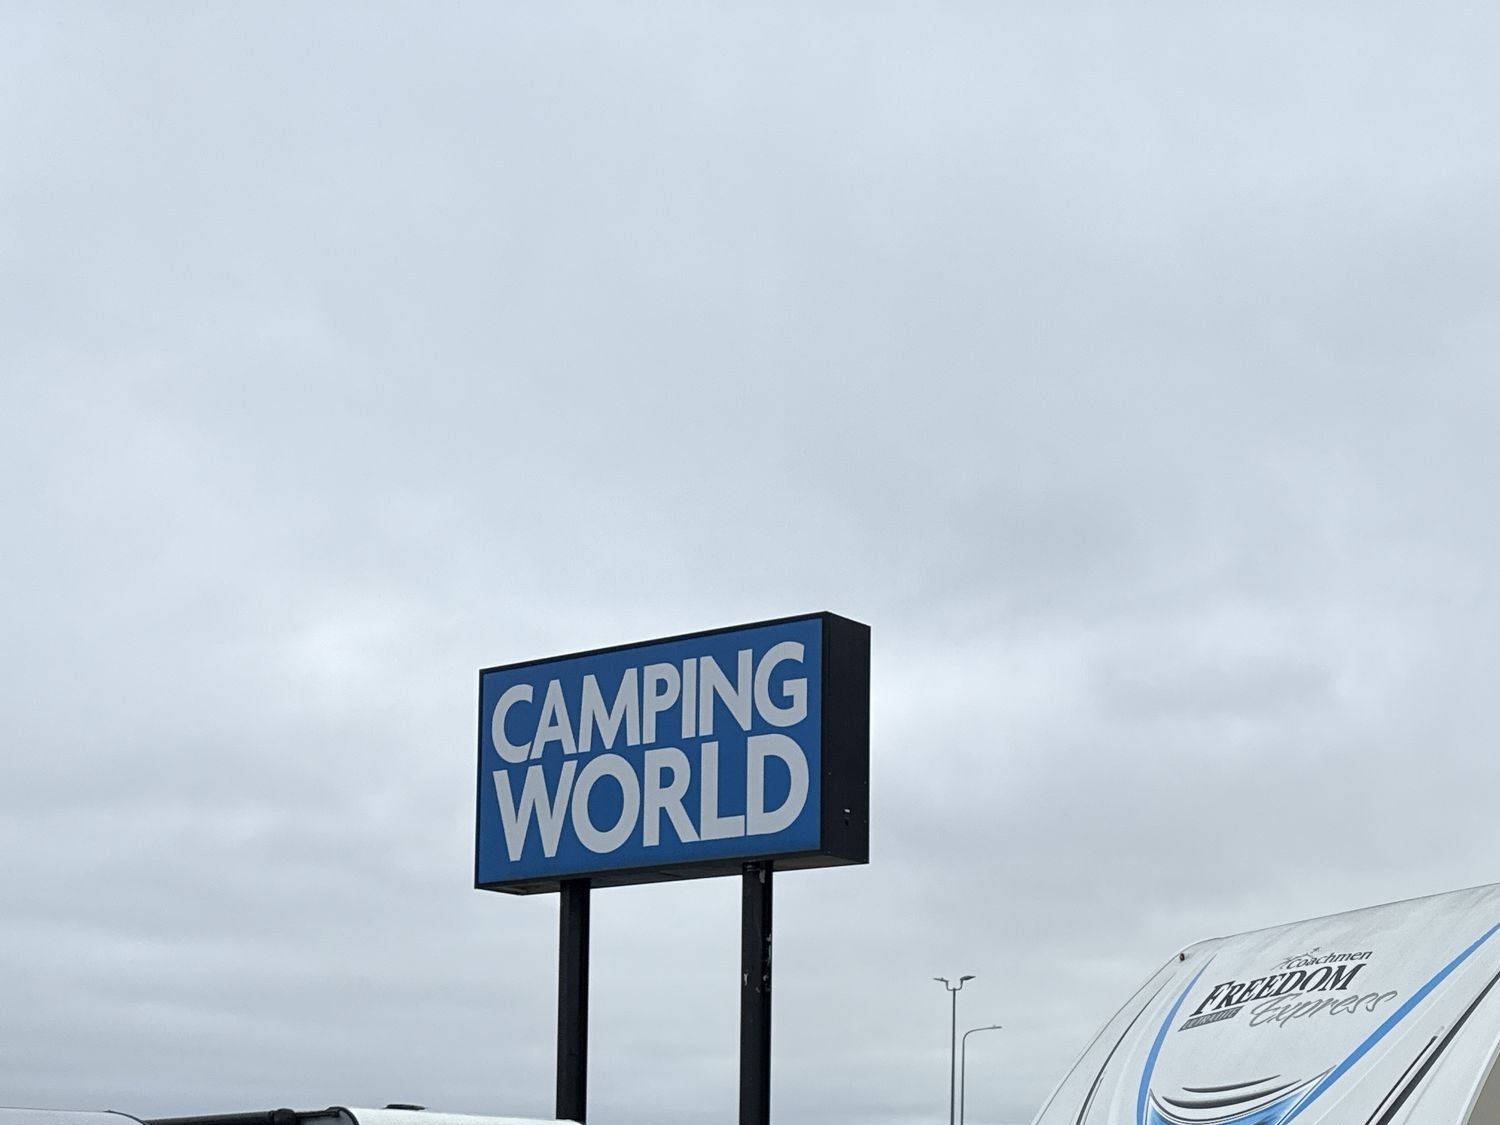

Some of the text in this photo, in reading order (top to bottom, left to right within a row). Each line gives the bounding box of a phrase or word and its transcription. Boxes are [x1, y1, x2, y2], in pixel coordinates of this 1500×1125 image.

[491, 641, 808, 764] CAMPING
[492, 733, 810, 863] WORLD
[1286, 951, 1373, 969] Coachmen
[1189, 963, 1367, 1017] FREEDOM
[1249, 990, 1398, 1028] Express
